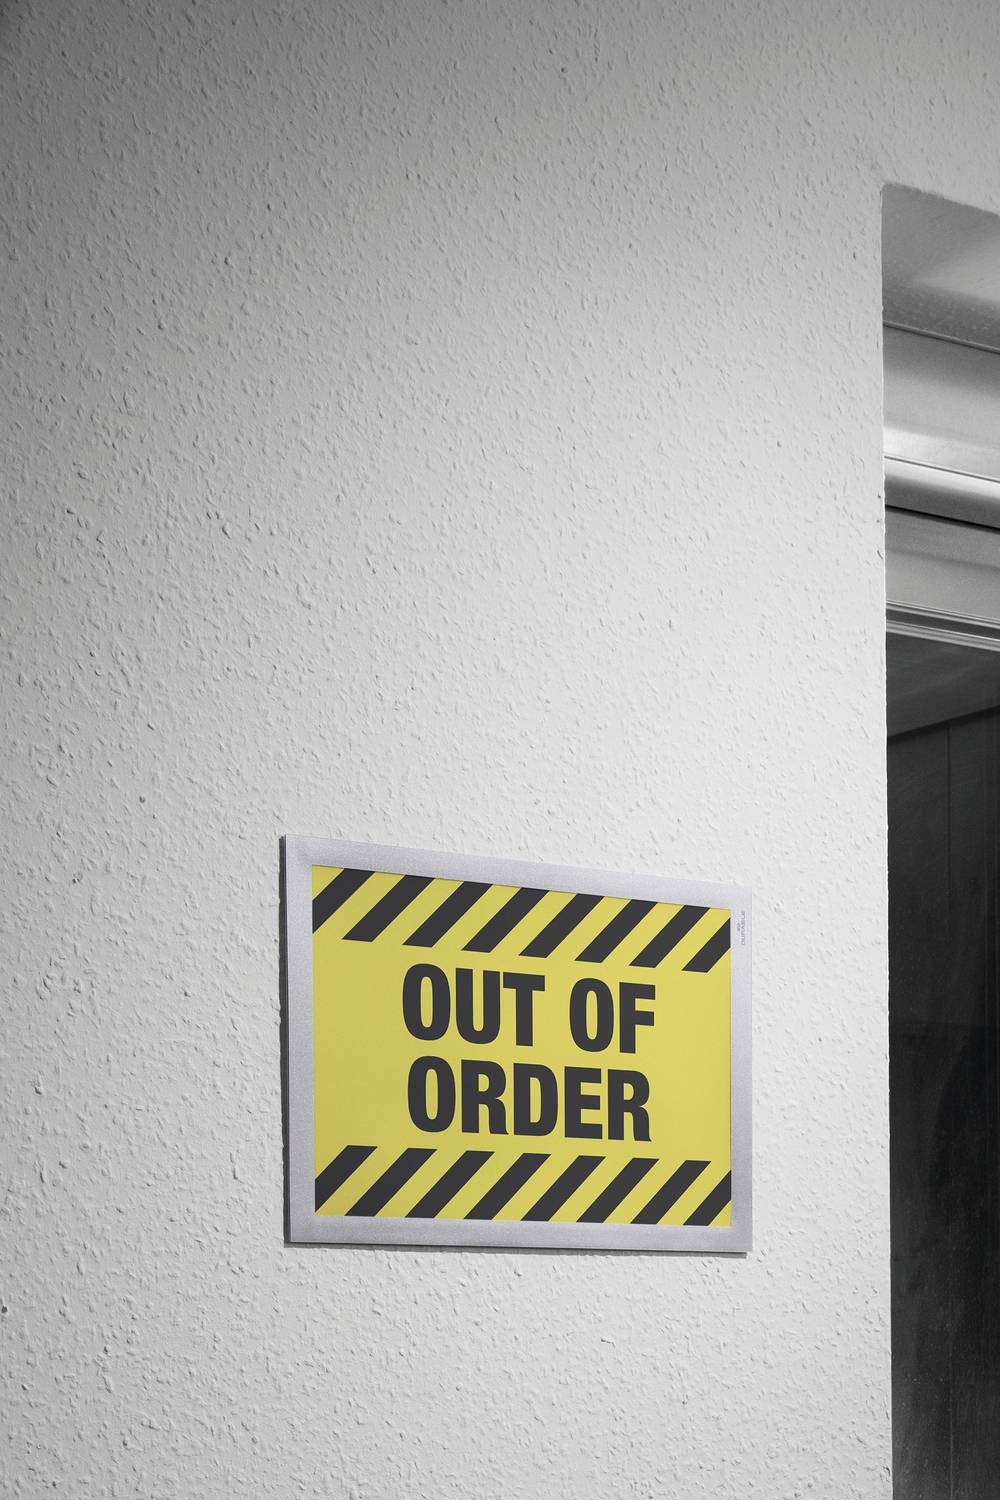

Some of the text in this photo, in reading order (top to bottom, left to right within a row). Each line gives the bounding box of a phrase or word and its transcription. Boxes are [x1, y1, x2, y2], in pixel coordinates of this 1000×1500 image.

[402, 963, 656, 1054] OUT OF
[407, 1055, 652, 1142] ORDER
